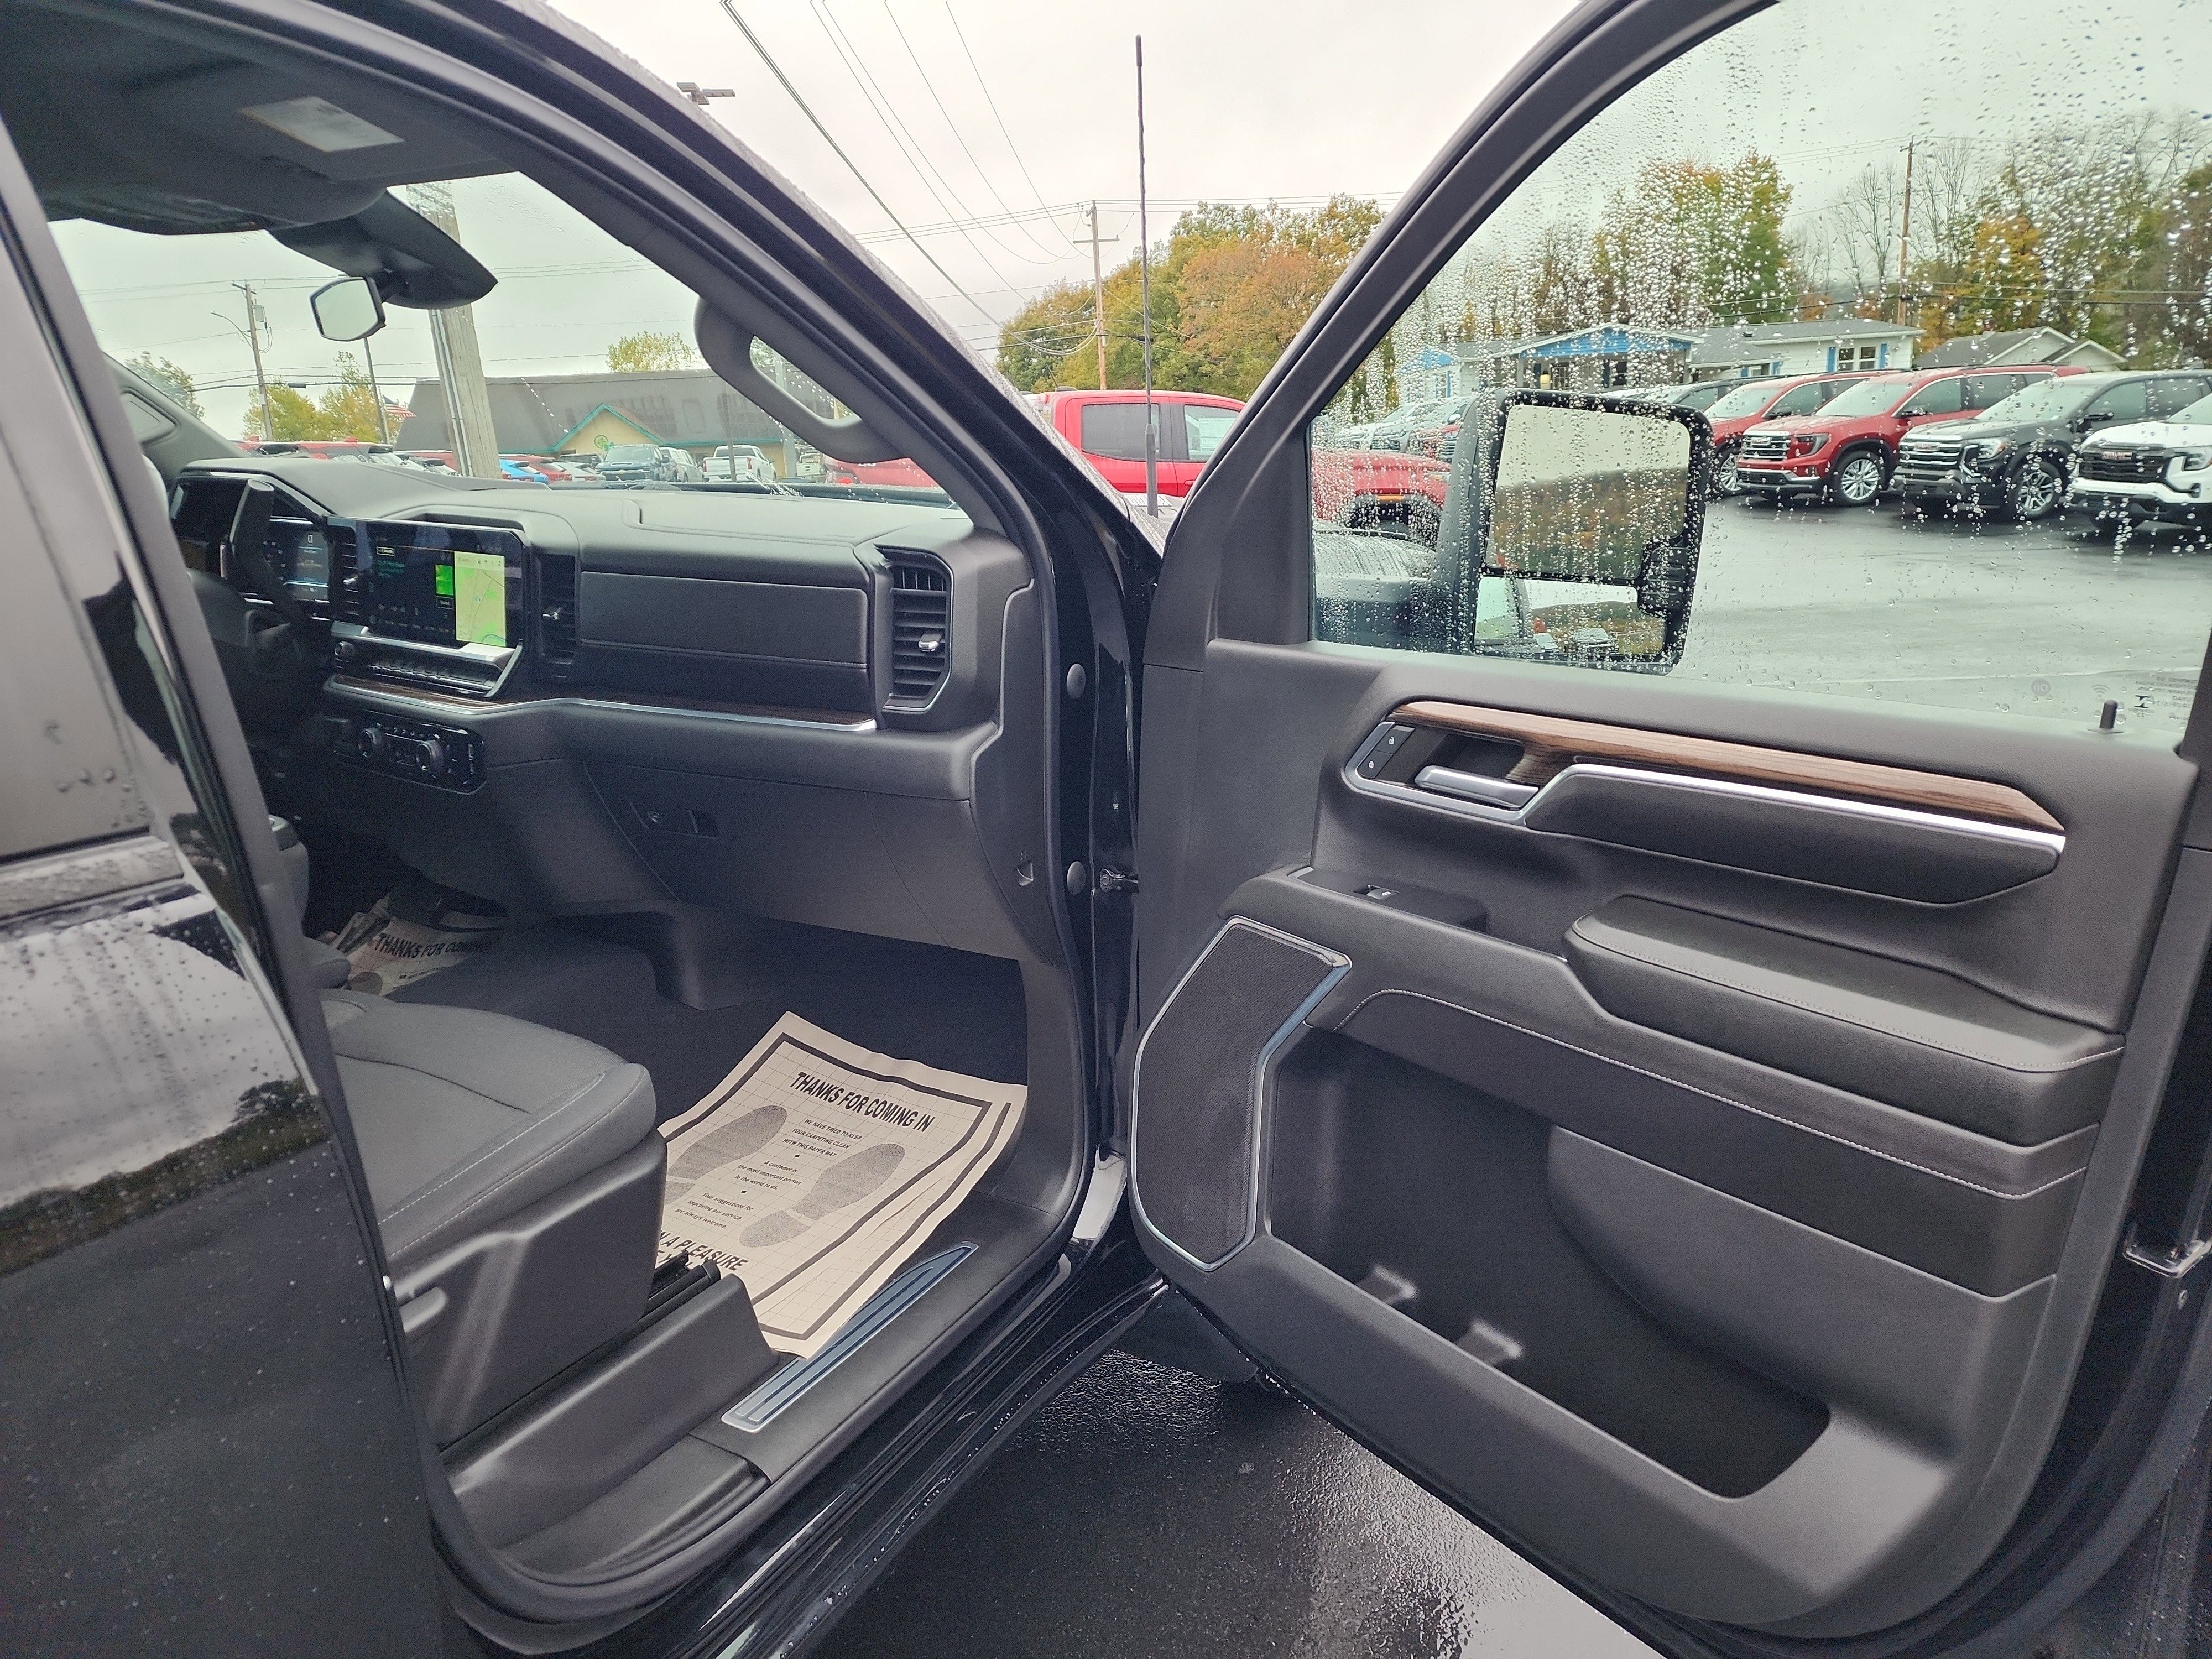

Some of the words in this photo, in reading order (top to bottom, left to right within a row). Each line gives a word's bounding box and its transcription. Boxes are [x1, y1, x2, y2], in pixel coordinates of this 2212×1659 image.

[374, 932, 422, 958] THANKS
[420, 942, 446, 957] FOR
[790, 1072, 844, 1103] THANKS
[838, 1091, 870, 1113] FOR
[864, 1098, 918, 1127] COMING
[913, 1114, 936, 1133] IN
[812, 1121, 827, 1130] HAVE
[827, 1126, 842, 1135] TRIED
[805, 1133, 834, 1145] CARPETING
[834, 1141, 851, 1149] CLEAN
[808, 1145, 827, 1155] PAPER
[746, 1166, 760, 1175] most
[759, 1170, 784, 1182] important
[783, 1177, 802, 1185] person
[768, 1162, 791, 1172] customer
[687, 1200, 713, 1212] improving
[722, 1211, 742, 1220] service
[713, 1197, 745, 1210] suggestions
[684, 1212, 703, 1220] always
[702, 1218, 727, 1229] welcome.
[661, 1237, 680, 1247] A
[673, 1239, 749, 1271] PLEASURE
